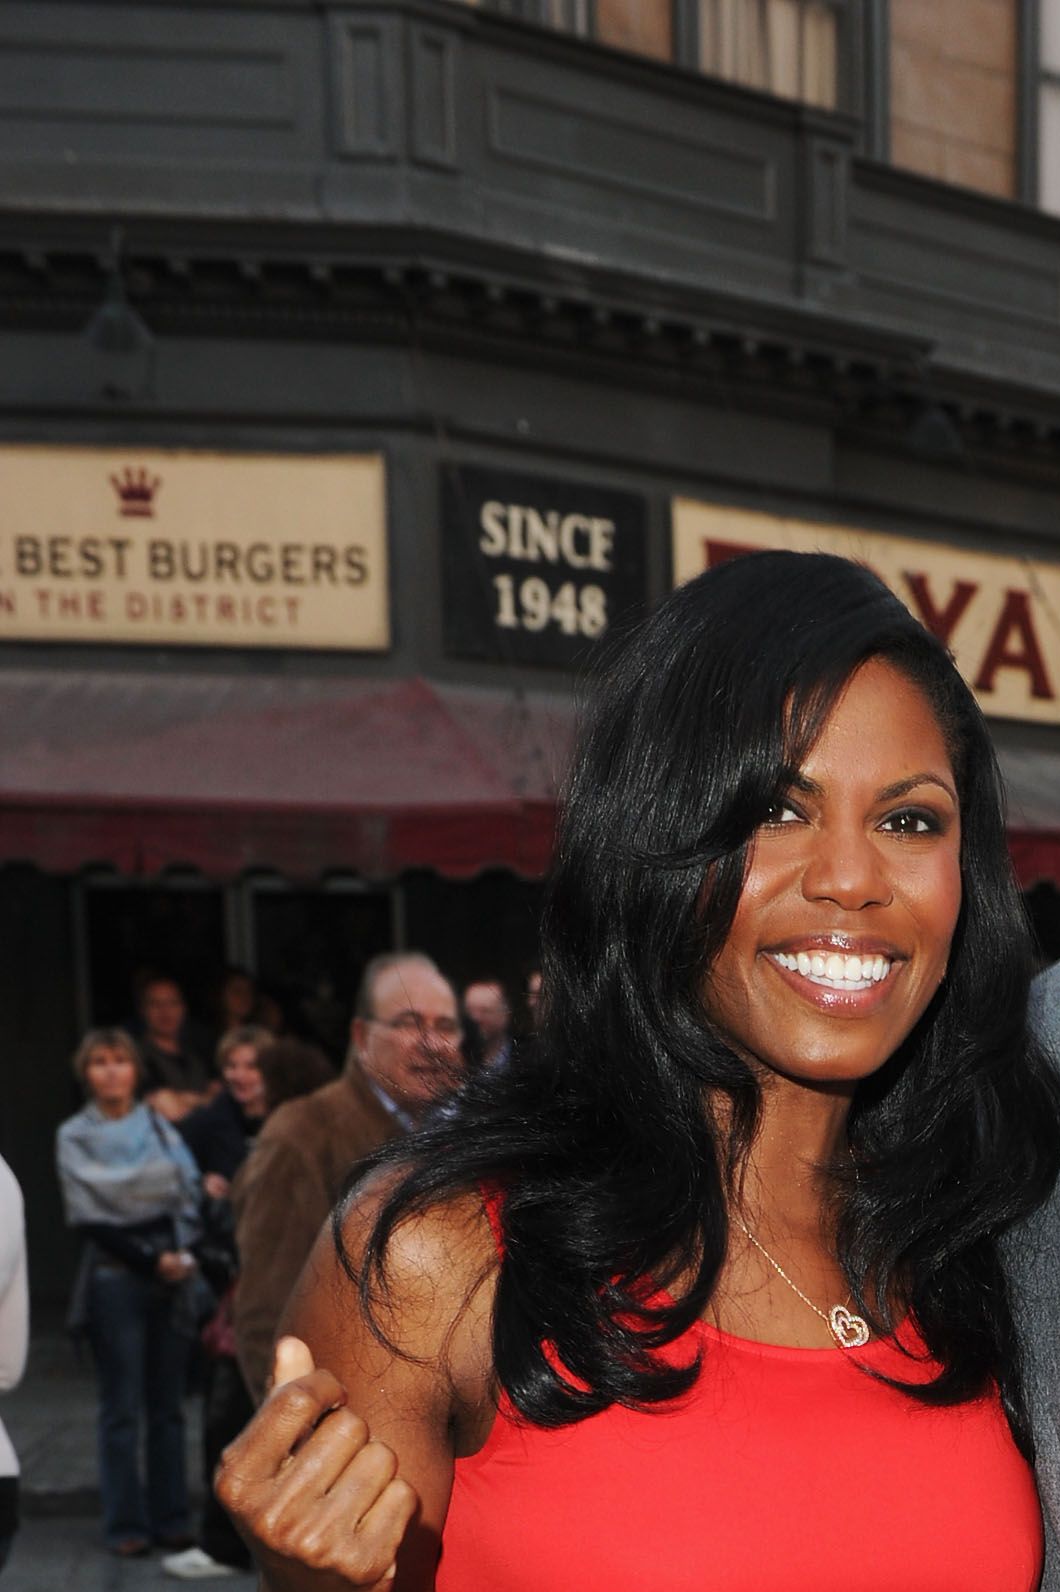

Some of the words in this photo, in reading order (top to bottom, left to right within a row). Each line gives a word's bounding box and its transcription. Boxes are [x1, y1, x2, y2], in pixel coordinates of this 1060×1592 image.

[15, 533, 132, 580] BEST
[148, 540, 369, 588] BURGERS
[480, 501, 615, 570] SINCE
[34, 588, 103, 620] THE
[126, 592, 302, 626] DISTRICT
[494, 575, 607, 637] 1948
